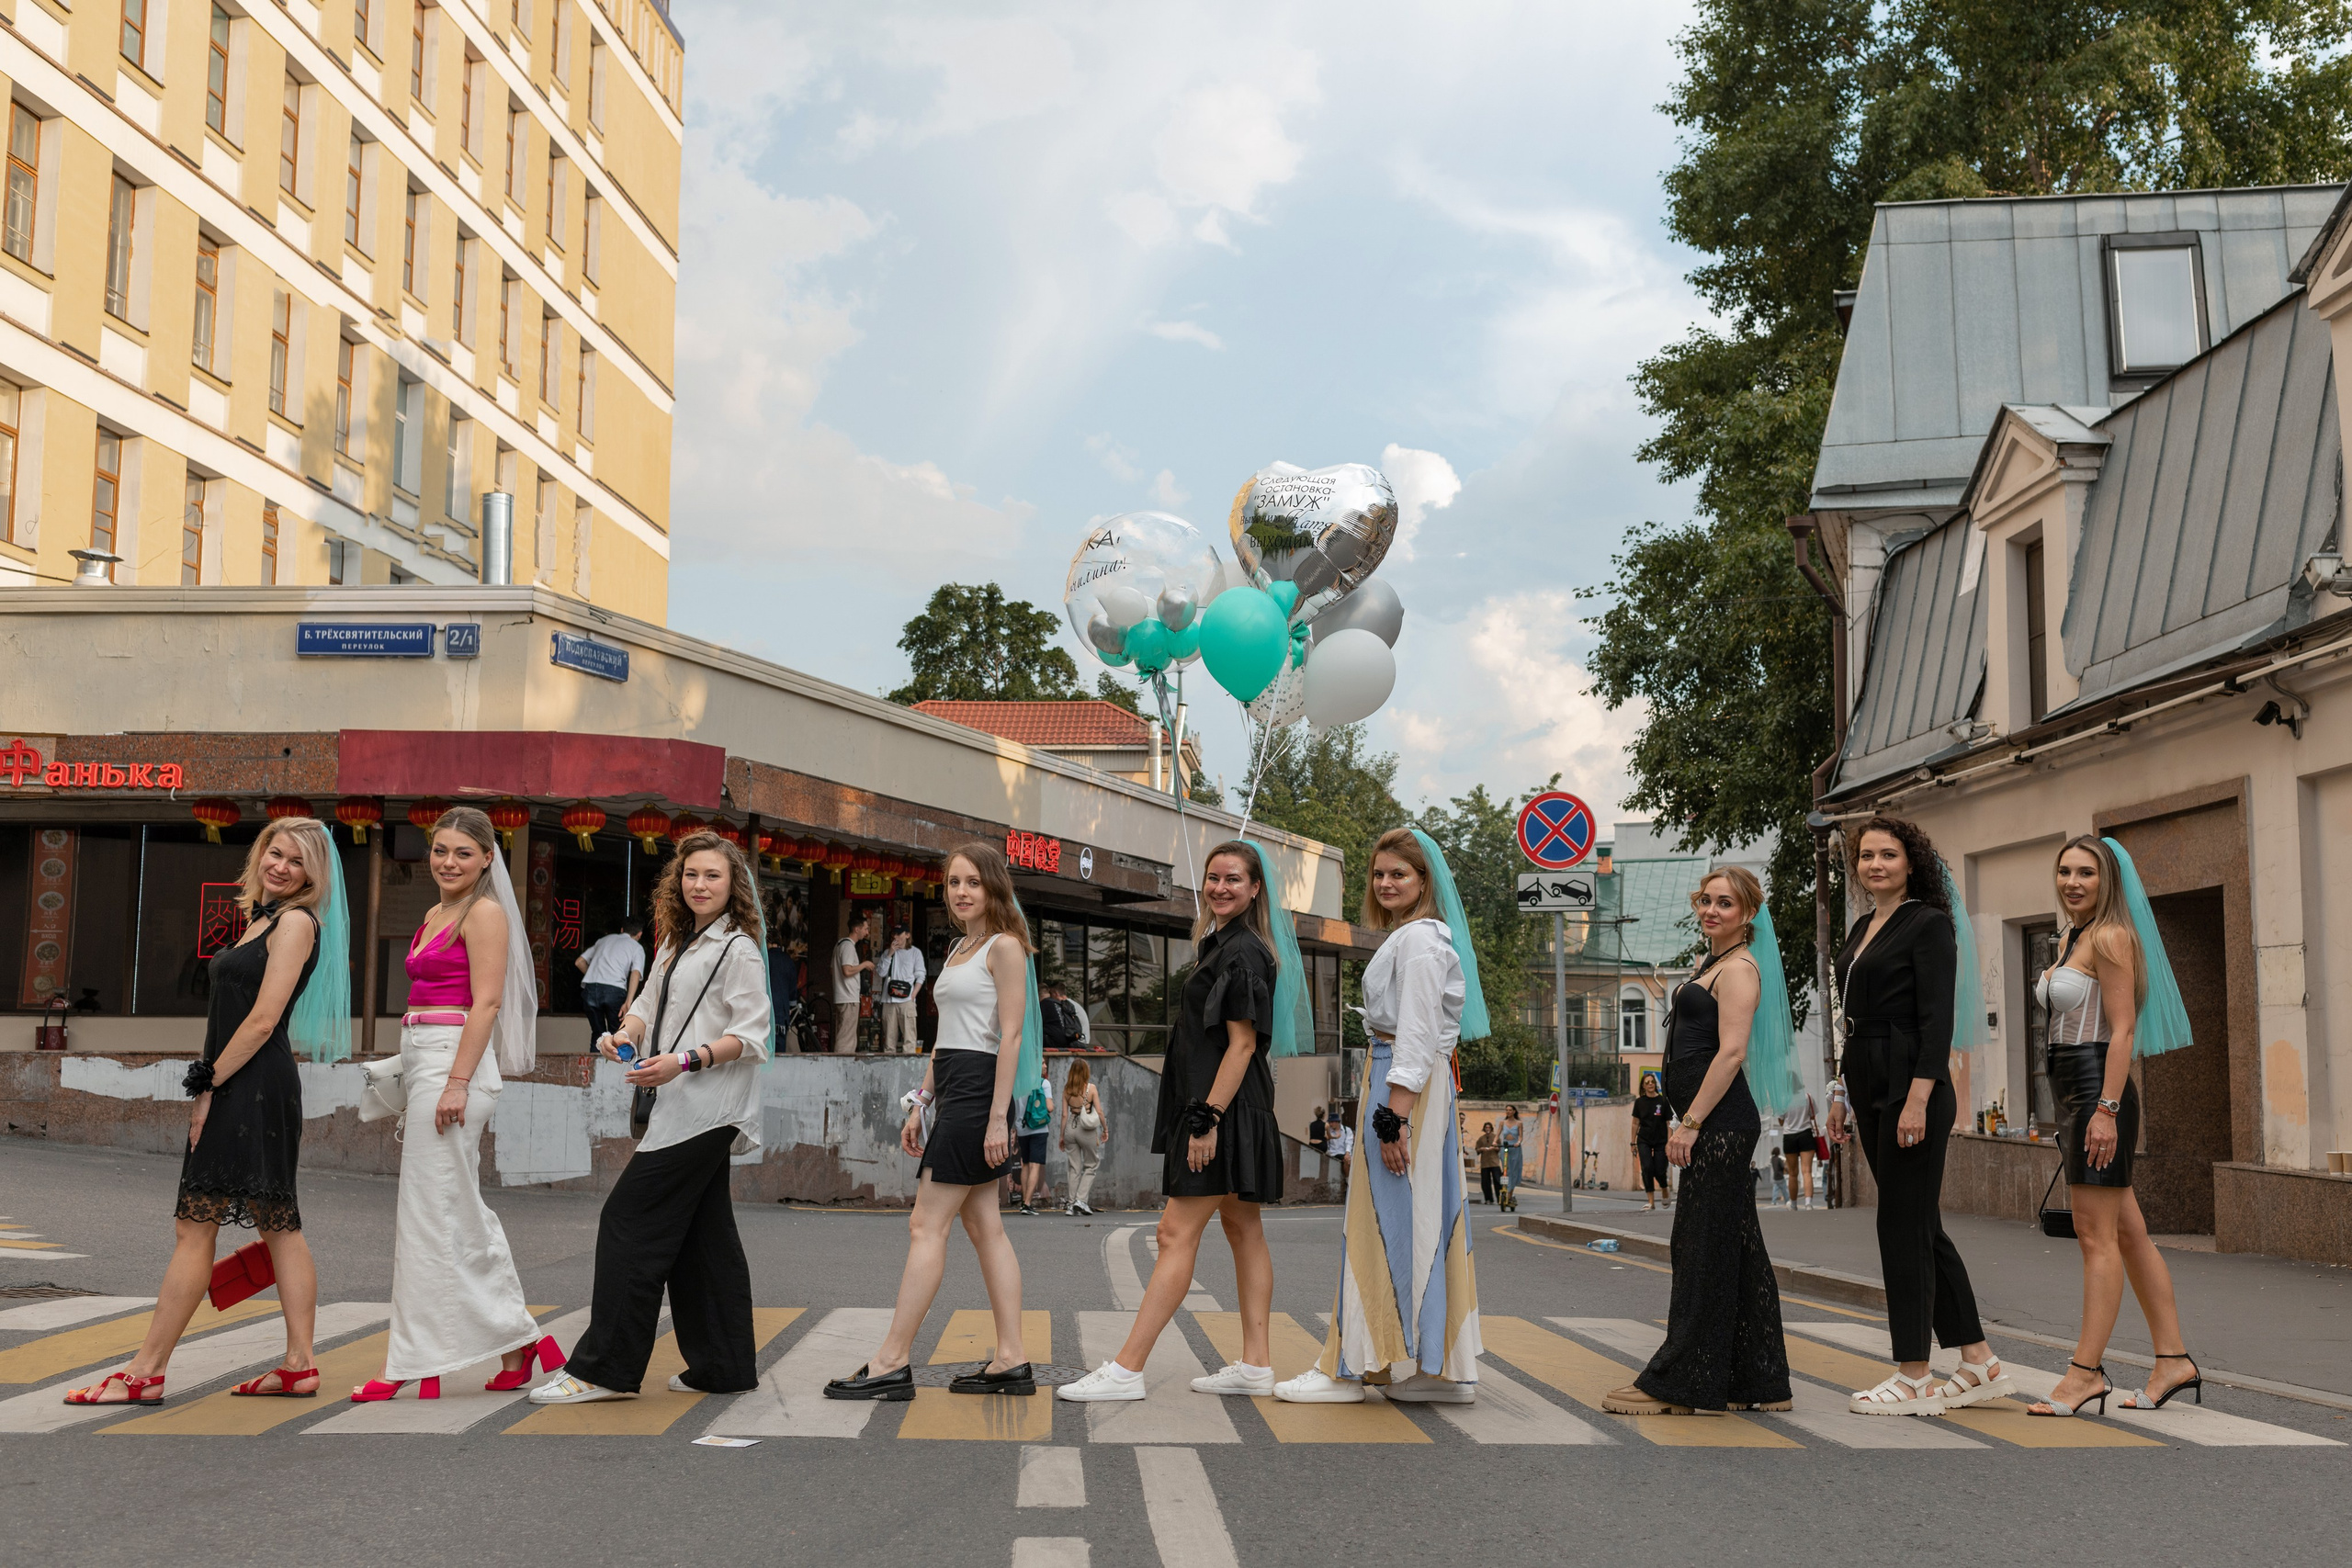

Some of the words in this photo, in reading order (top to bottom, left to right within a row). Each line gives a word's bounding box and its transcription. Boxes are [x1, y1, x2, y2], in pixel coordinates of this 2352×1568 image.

[1260, 475, 1337, 486] Следующая
[1253, 494, 1330, 510] "ЗАМУЖ"
[304, 630, 313, 640] Б.
[315, 628, 424, 641] ТРЁХСВЯТИТЕЛЬСКИЙ
[449, 629, 473, 648] 2/1
[552, 897, 582, 950] 湯
